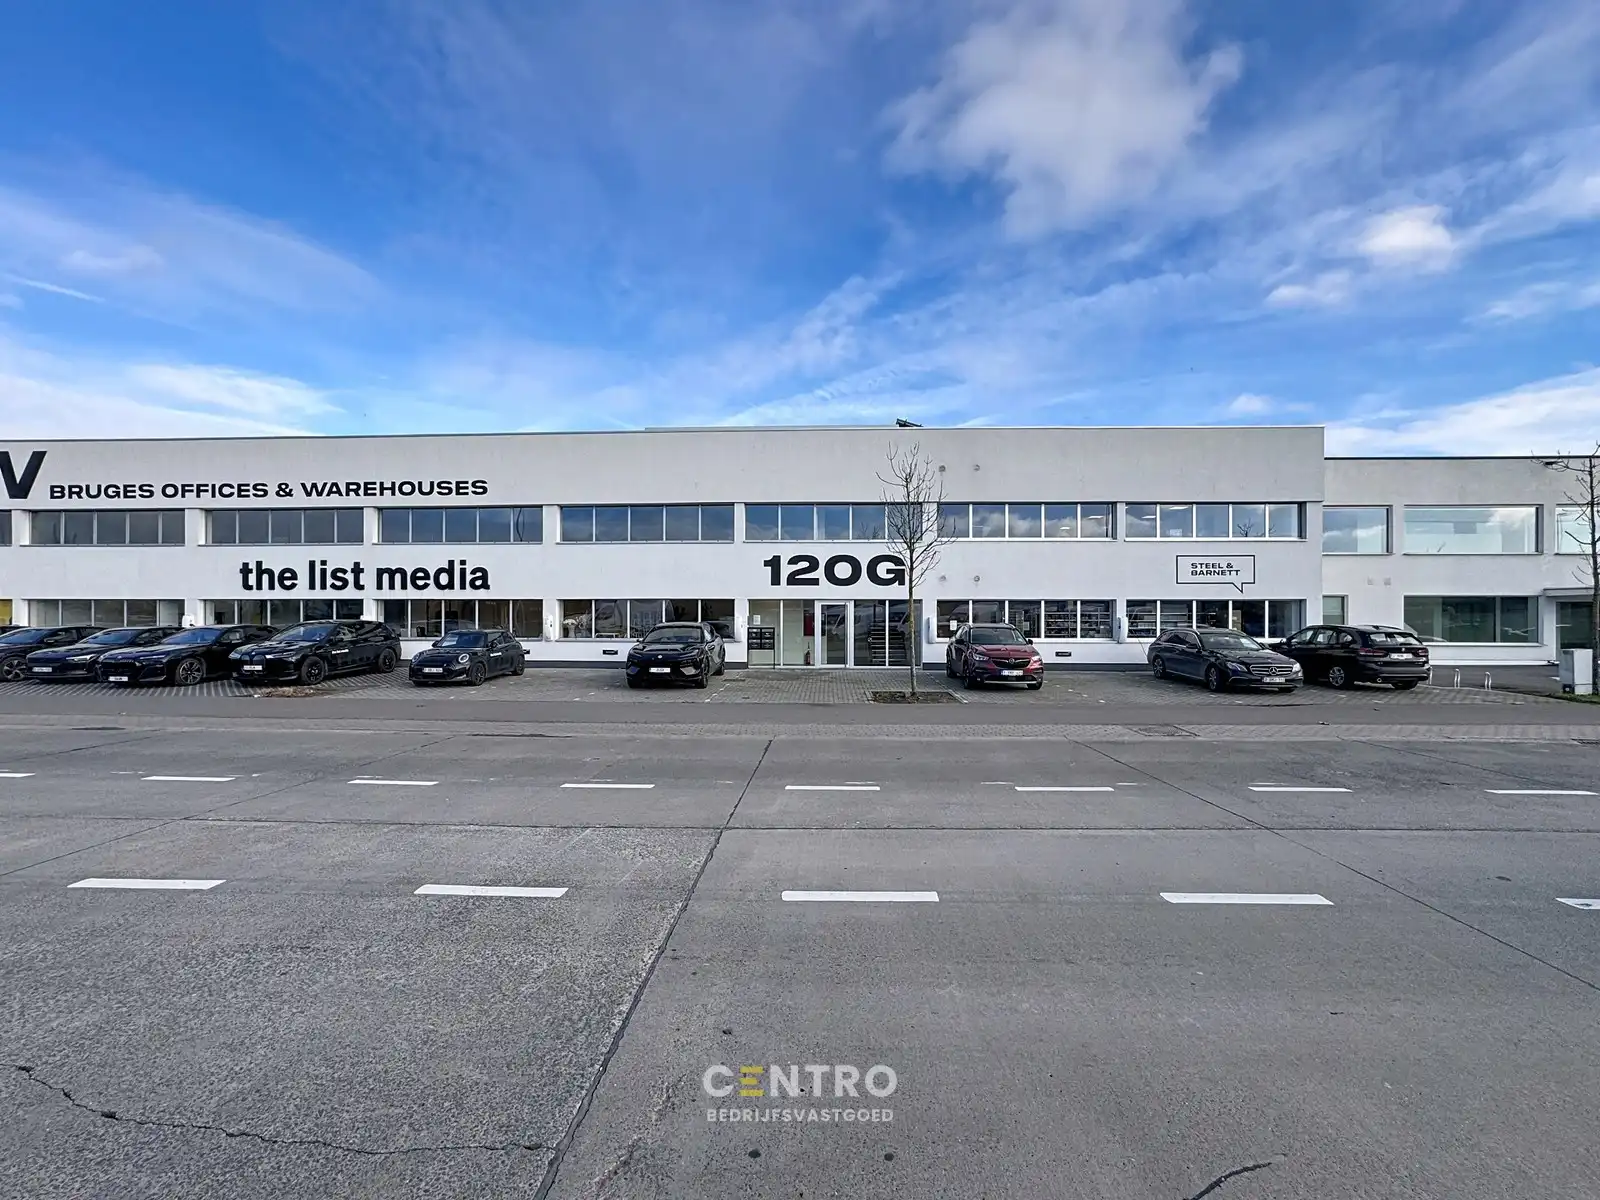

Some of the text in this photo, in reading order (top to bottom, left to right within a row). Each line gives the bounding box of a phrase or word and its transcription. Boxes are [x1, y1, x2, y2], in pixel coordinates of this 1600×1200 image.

[50, 480, 488, 500] BRUGES OFFICES & WAREHOUSES
[240, 559, 490, 590] the list media
[763, 554, 906, 586] 120G
